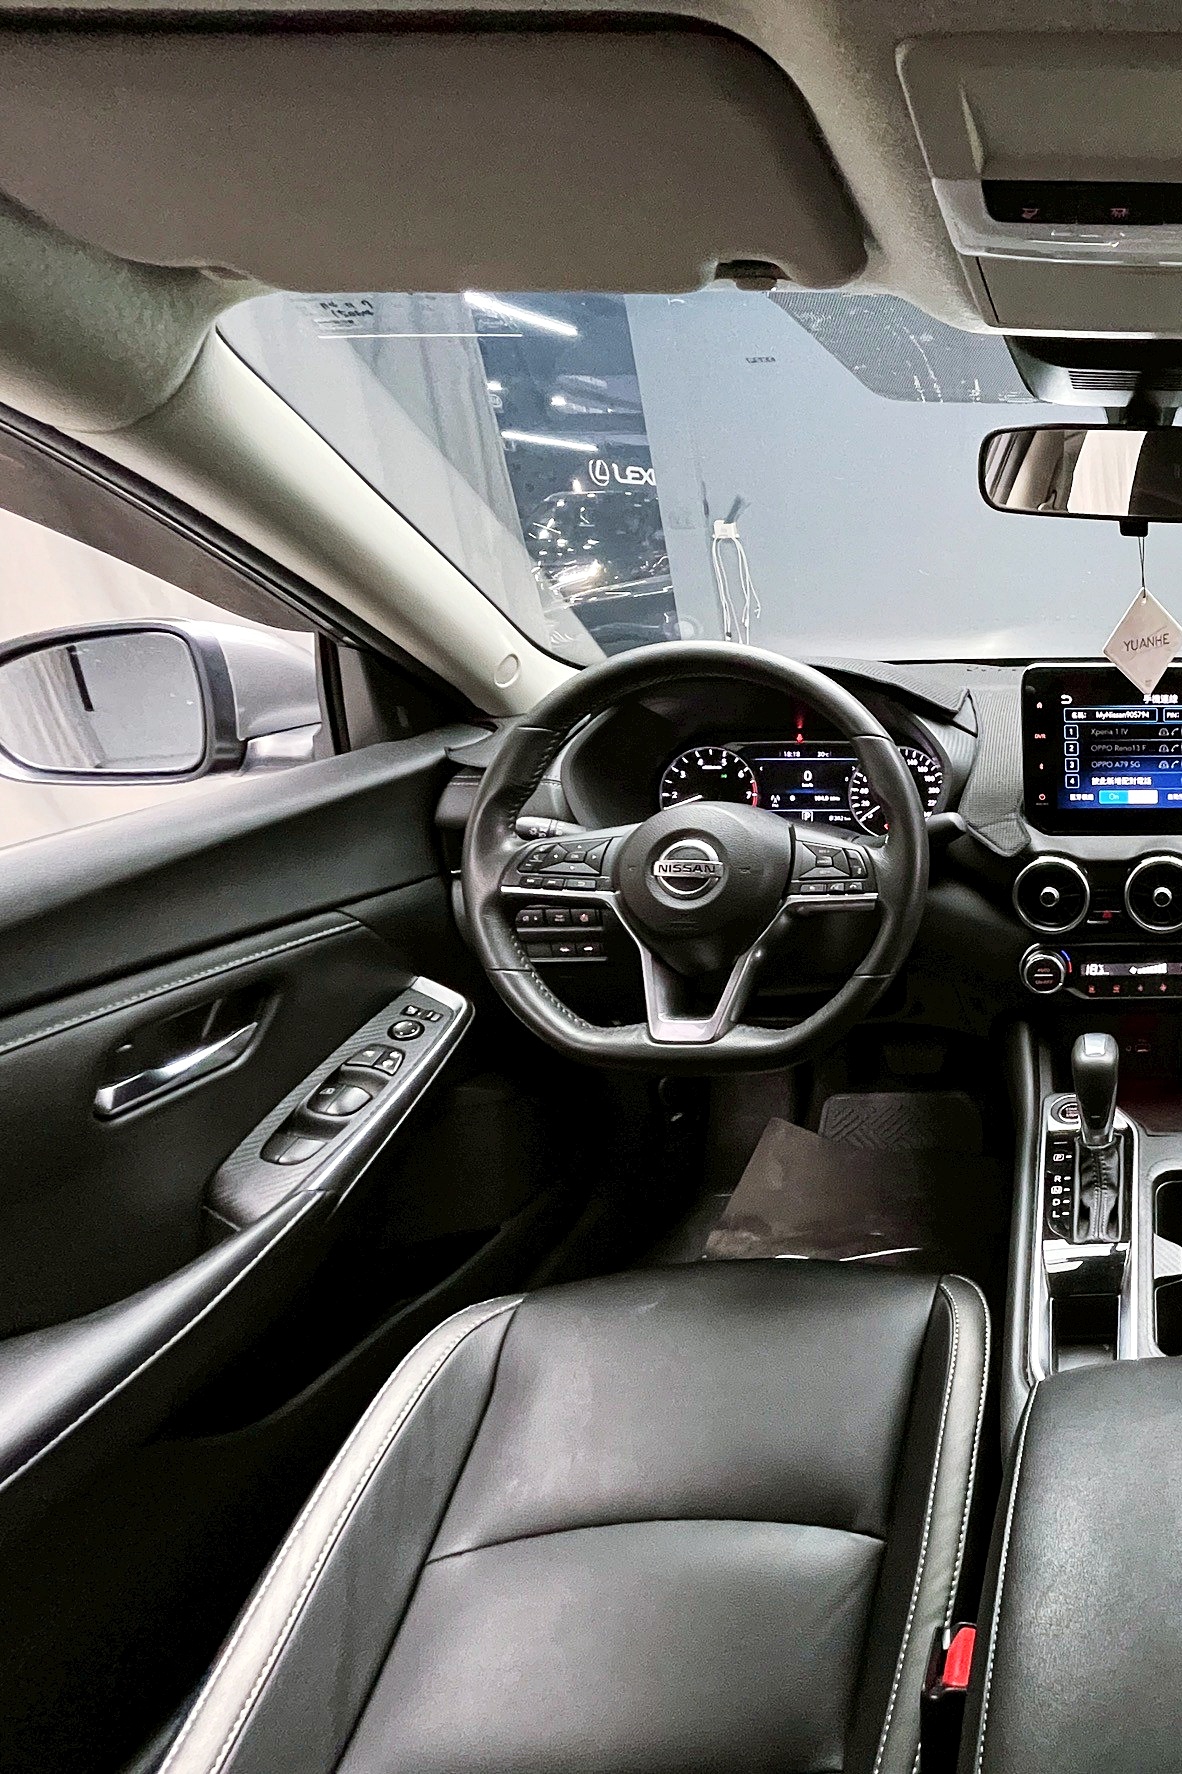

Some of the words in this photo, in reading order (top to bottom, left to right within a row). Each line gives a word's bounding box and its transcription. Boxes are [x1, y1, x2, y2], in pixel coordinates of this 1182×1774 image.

[1123, 633, 1169, 652] YUANHE
[1090, 728, 1113, 737] Xperia
[1090, 744, 1113, 752] OPPO
[1091, 761, 1113, 769] OPPO
[1113, 761, 1129, 769] A79
[803, 770, 813, 781] 0
[671, 791, 678, 799] 2
[745, 790, 752, 799] 7
[658, 864, 716, 874] NISSAN
[1052, 1198, 1061, 1206] D
[1052, 1210, 1061, 1218] L
